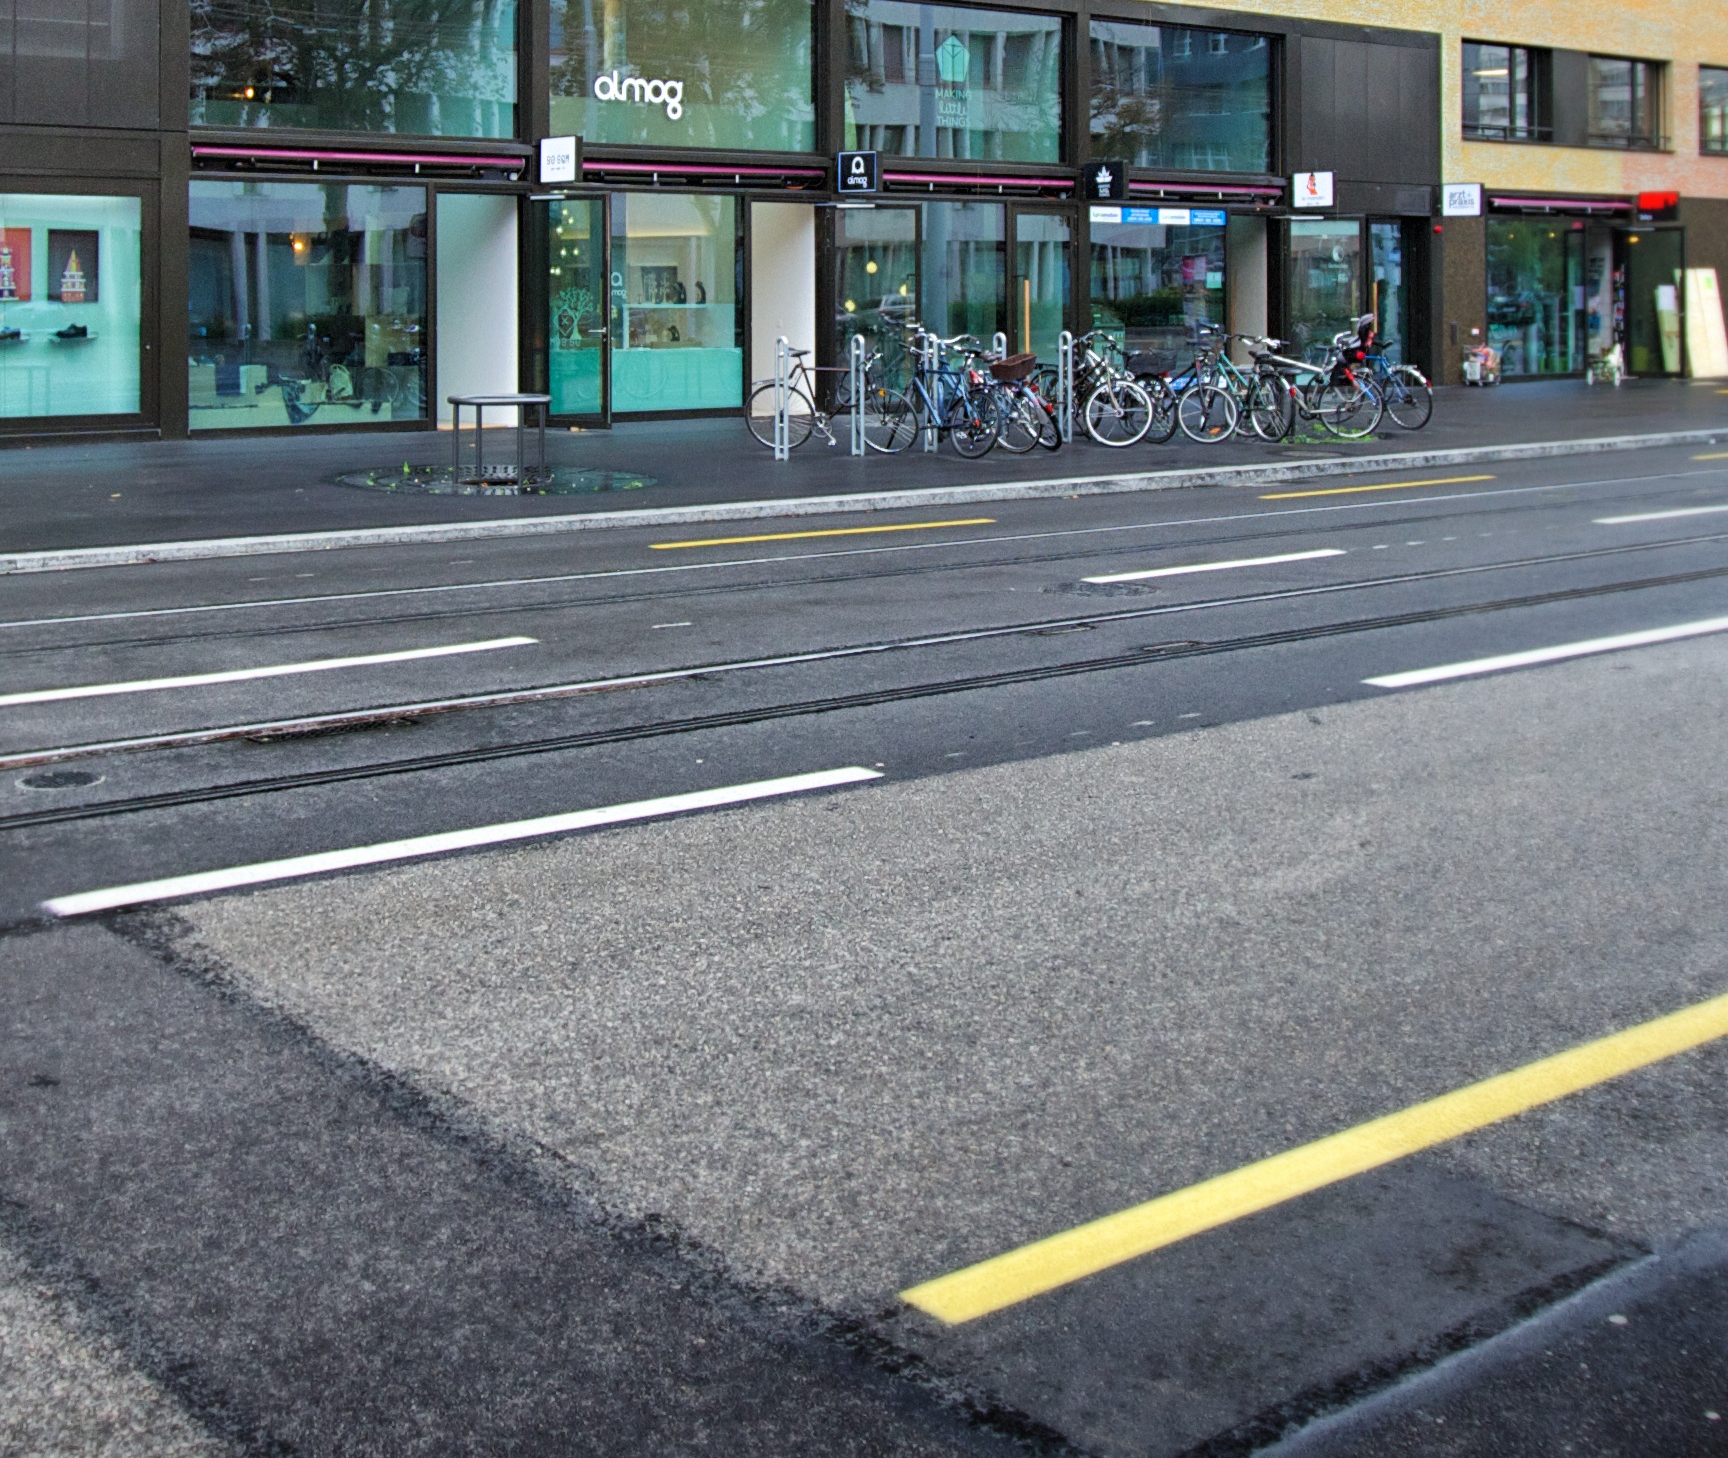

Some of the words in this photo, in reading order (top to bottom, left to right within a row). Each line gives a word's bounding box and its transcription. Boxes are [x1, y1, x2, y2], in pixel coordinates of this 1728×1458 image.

[594, 70, 683, 120] almog
[935, 88, 970, 100] MAKING
[939, 101, 968, 116] little
[936, 115, 971, 128] THINGS
[1449, 198, 1475, 209] praxis
